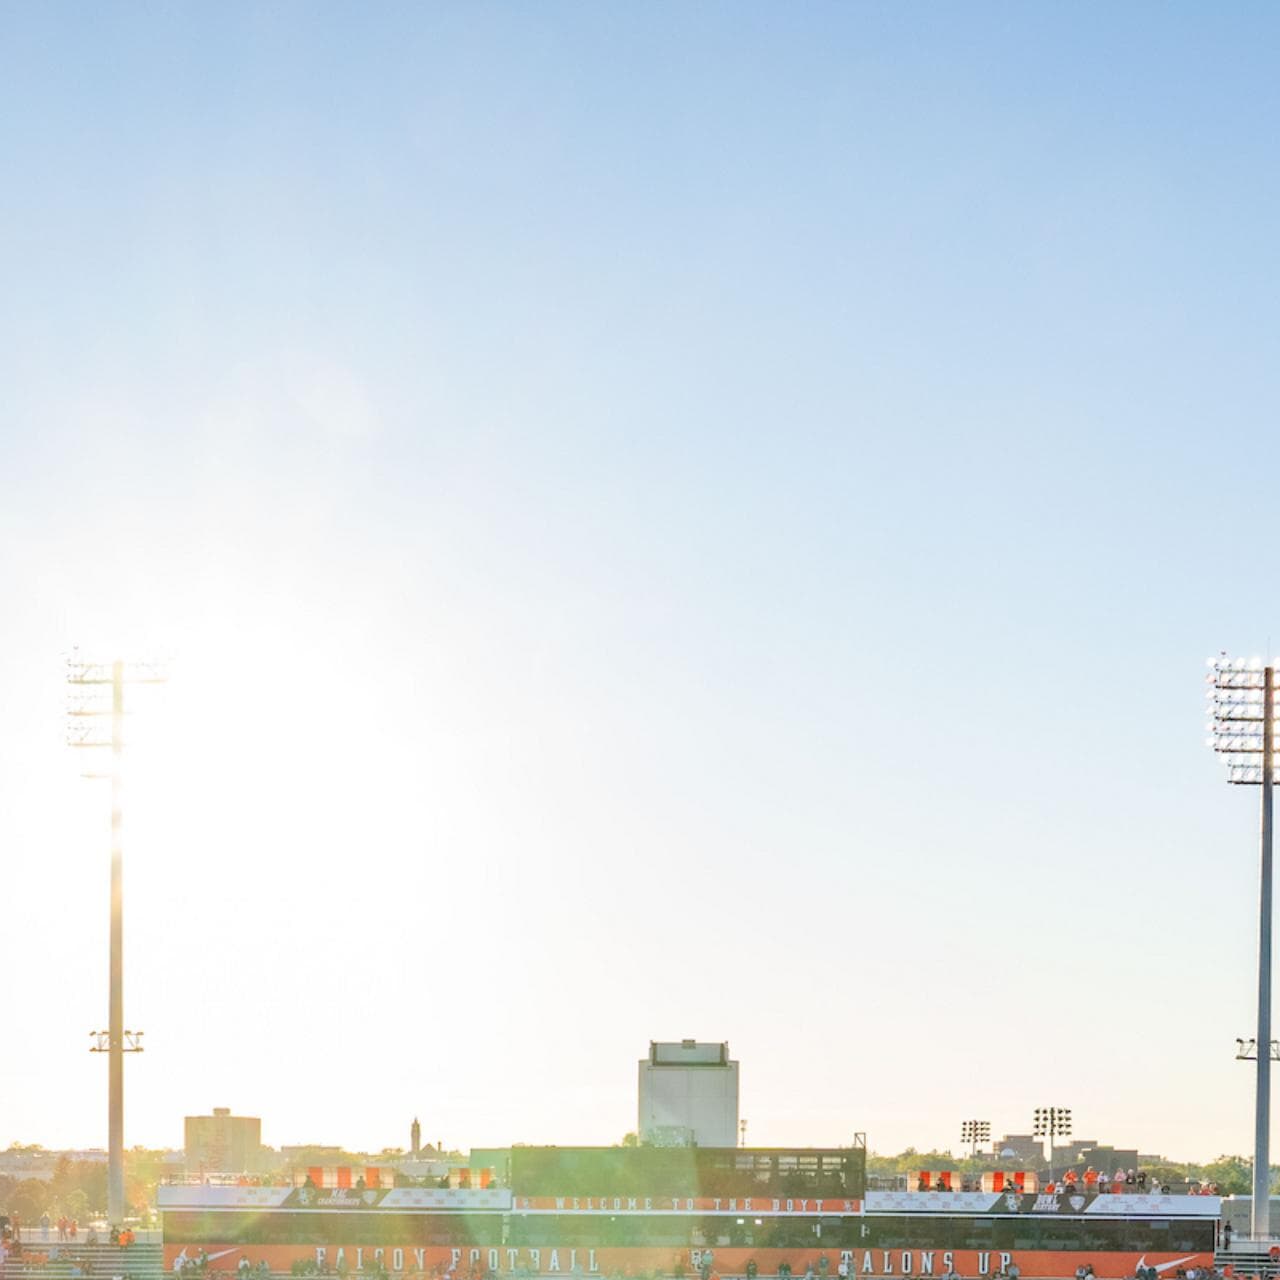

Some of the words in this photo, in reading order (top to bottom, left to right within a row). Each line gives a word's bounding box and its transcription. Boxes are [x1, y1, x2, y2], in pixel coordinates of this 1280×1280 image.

[556, 1198, 652, 1209] WELCOME
[671, 1199, 694, 1209] TO
[714, 1199, 751, 1210] THE
[771, 1200, 823, 1212] DOYT
[316, 1248, 425, 1272] FALCON
[451, 1248, 598, 1272] FOOTBALL
[840, 1251, 953, 1274] TALONS
[977, 1252, 1011, 1274] UP
